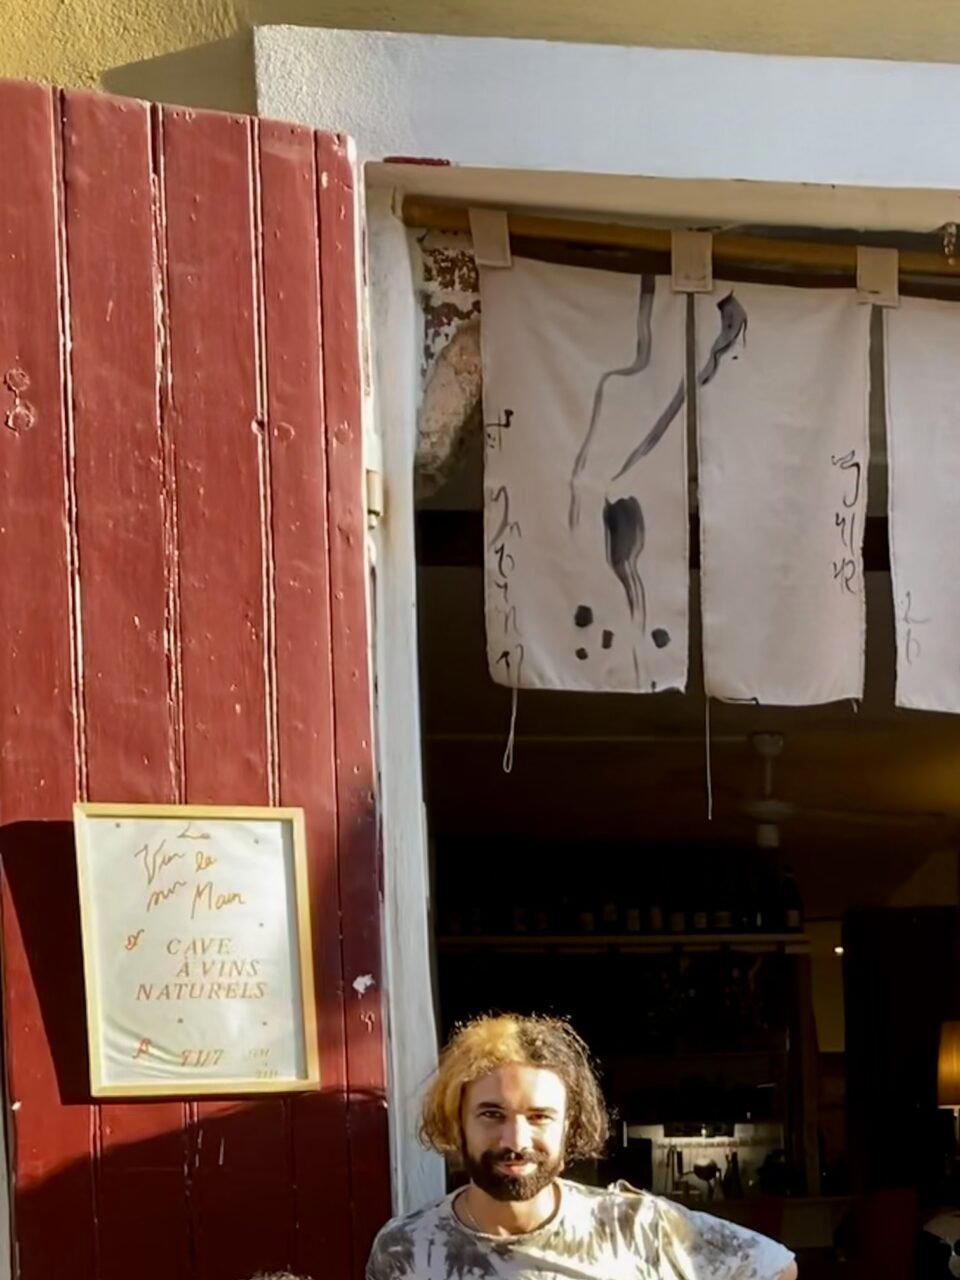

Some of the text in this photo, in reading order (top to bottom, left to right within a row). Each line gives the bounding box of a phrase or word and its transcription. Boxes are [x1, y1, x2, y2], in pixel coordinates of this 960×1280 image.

[166, 937, 231, 956] CAVE
[202, 959, 260, 978] VINS
[136, 981, 267, 1001] NATURELS
